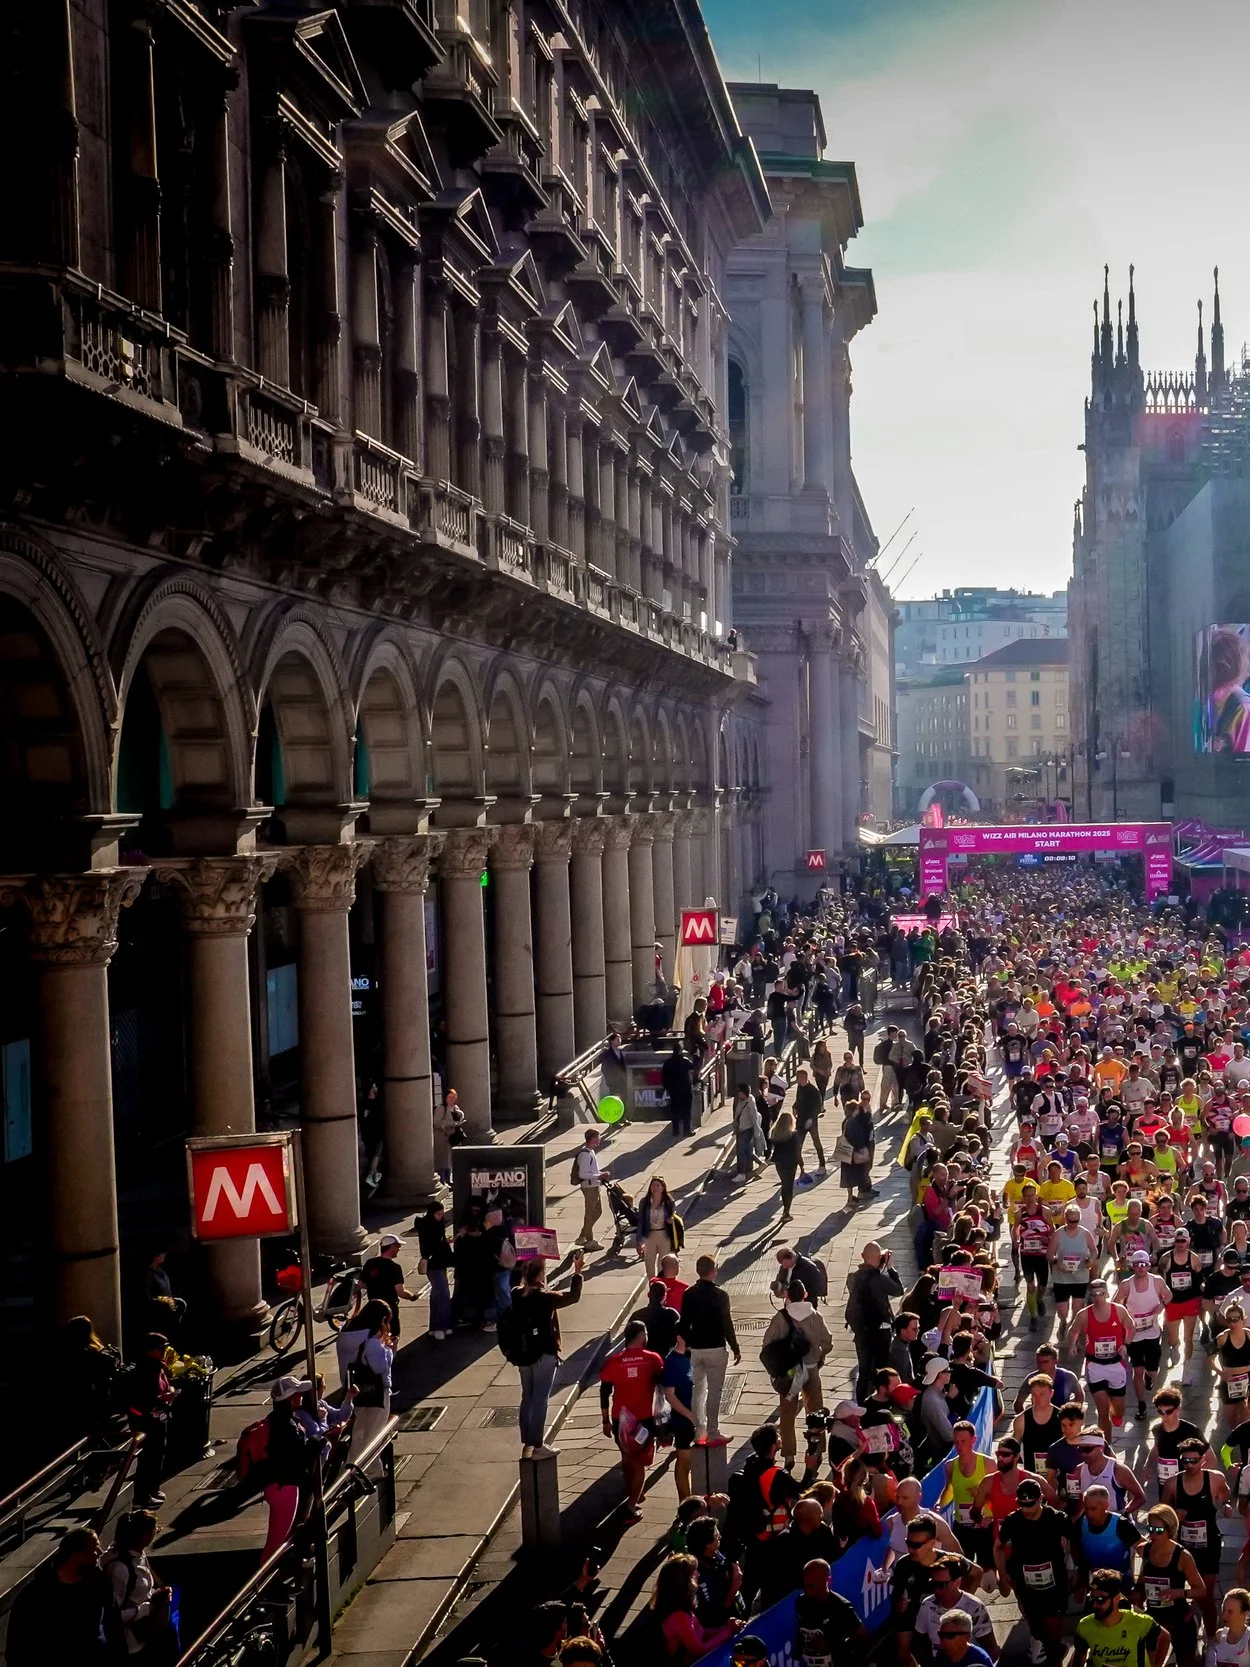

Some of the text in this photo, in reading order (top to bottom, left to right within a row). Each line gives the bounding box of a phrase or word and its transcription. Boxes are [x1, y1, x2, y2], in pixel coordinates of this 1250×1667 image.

[1018, 831, 1048, 839] MILANO
[1049, 830, 1092, 838] MARATHON
[1034, 840, 1061, 848] START
[809, 854, 823, 866] M
[684, 917, 714, 939] M
[471, 1171, 526, 1183] MILANO
[202, 1163, 283, 1221] M
